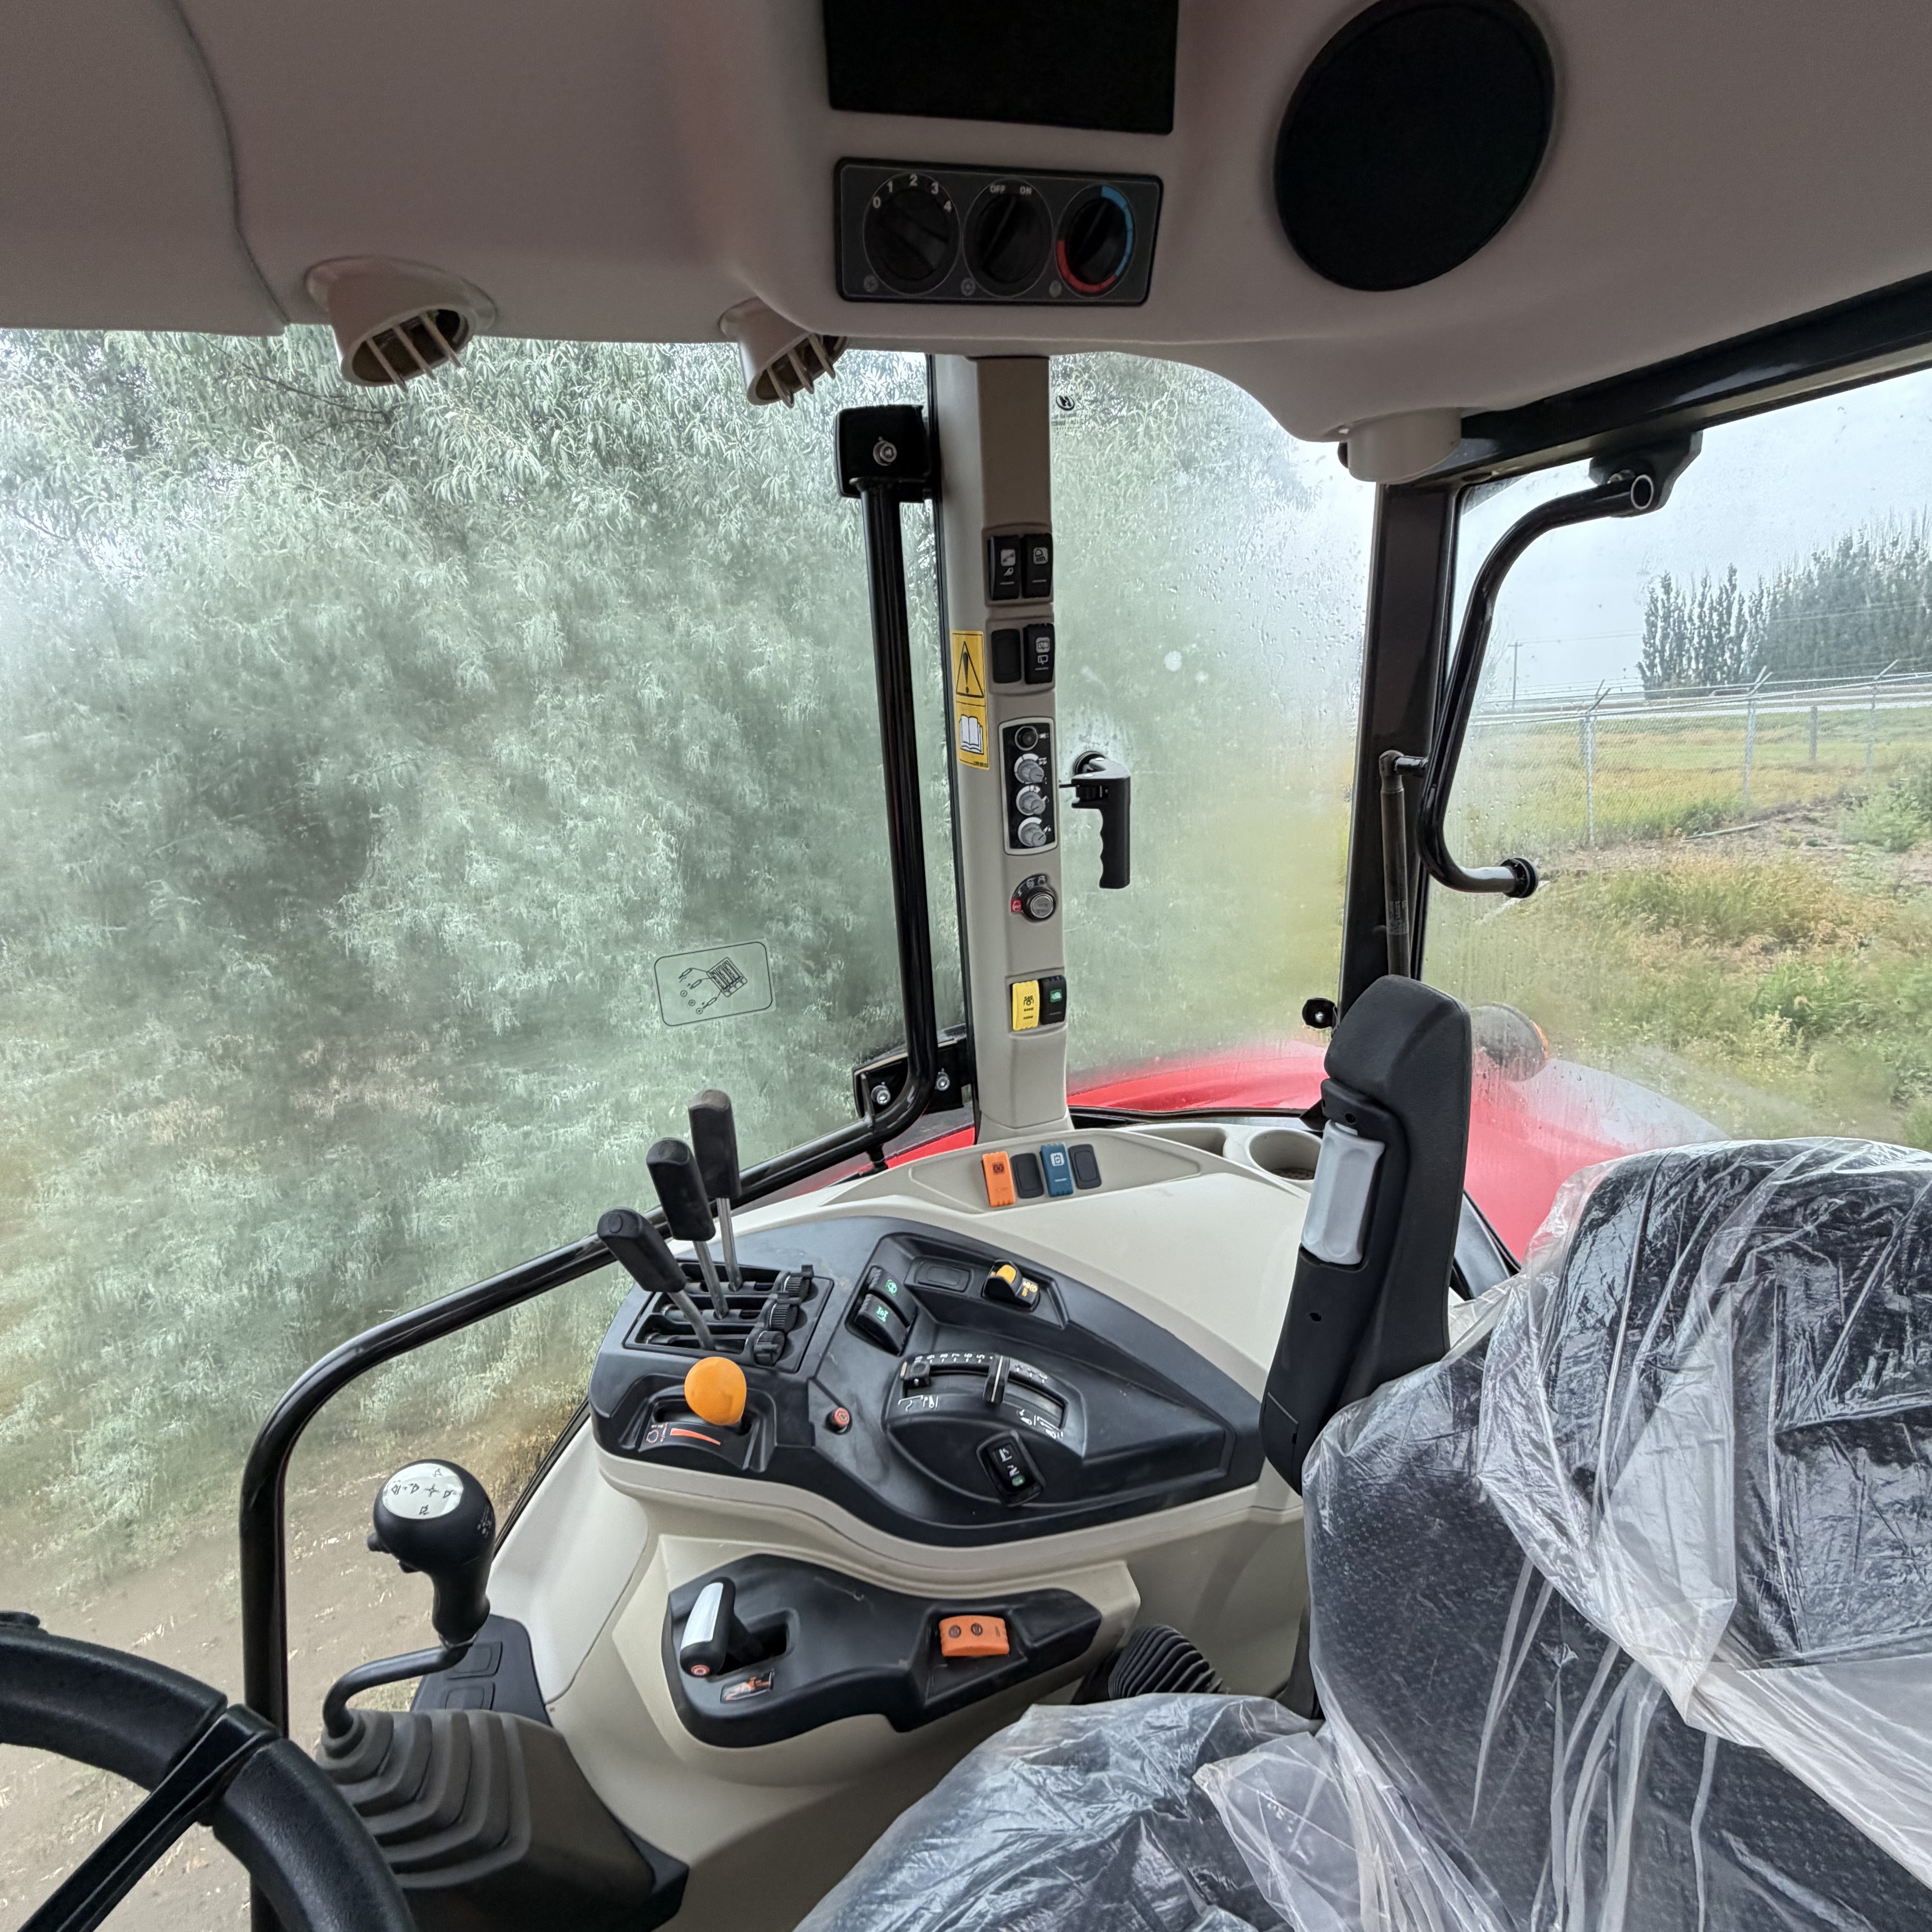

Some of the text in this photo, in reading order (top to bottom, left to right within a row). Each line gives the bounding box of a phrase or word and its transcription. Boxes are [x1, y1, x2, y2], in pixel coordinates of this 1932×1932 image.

[873, 174, 952, 212] 0 1 2 3 4
[990, 184, 1032, 195] OFF ON
